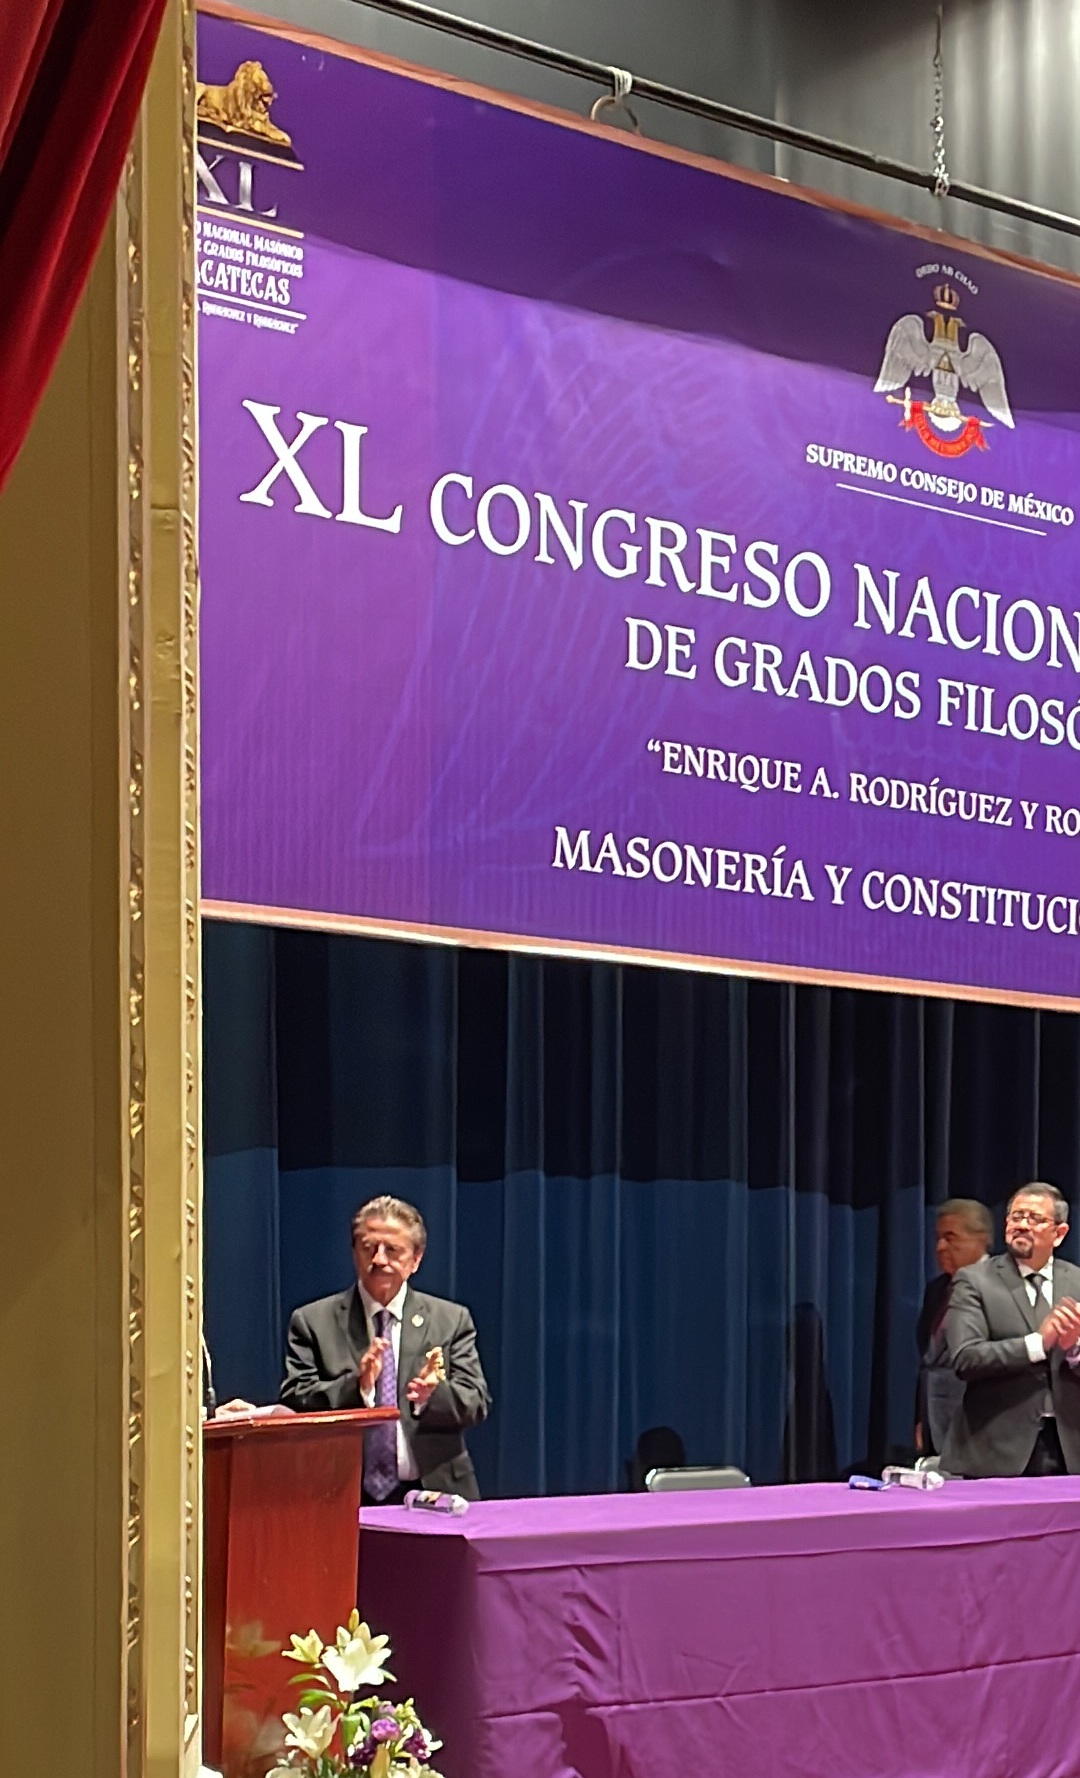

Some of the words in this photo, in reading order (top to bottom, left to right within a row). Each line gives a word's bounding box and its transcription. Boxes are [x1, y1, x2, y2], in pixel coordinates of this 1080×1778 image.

[197, 259, 291, 306] CATECAS
[239, 398, 403, 535] XL
[429, 472, 832, 619] CONGRESO
[806, 443, 897, 483] SUPREMO
[900, 467, 977, 504] CONSEJO
[980, 486, 1005, 510] DE
[1007, 492, 1075, 526] MÉXICO
[624, 616, 697, 680] DE
[714, 636, 922, 720] GRADOS
[646, 738, 802, 793] “ENRIQUE
[809, 766, 840, 799] A.
[848, 773, 1013, 828] RODRÍGUEZ
[1018, 800, 1040, 830] Y
[552, 825, 815, 901] MASONERÍA
[824, 863, 853, 906] Y
